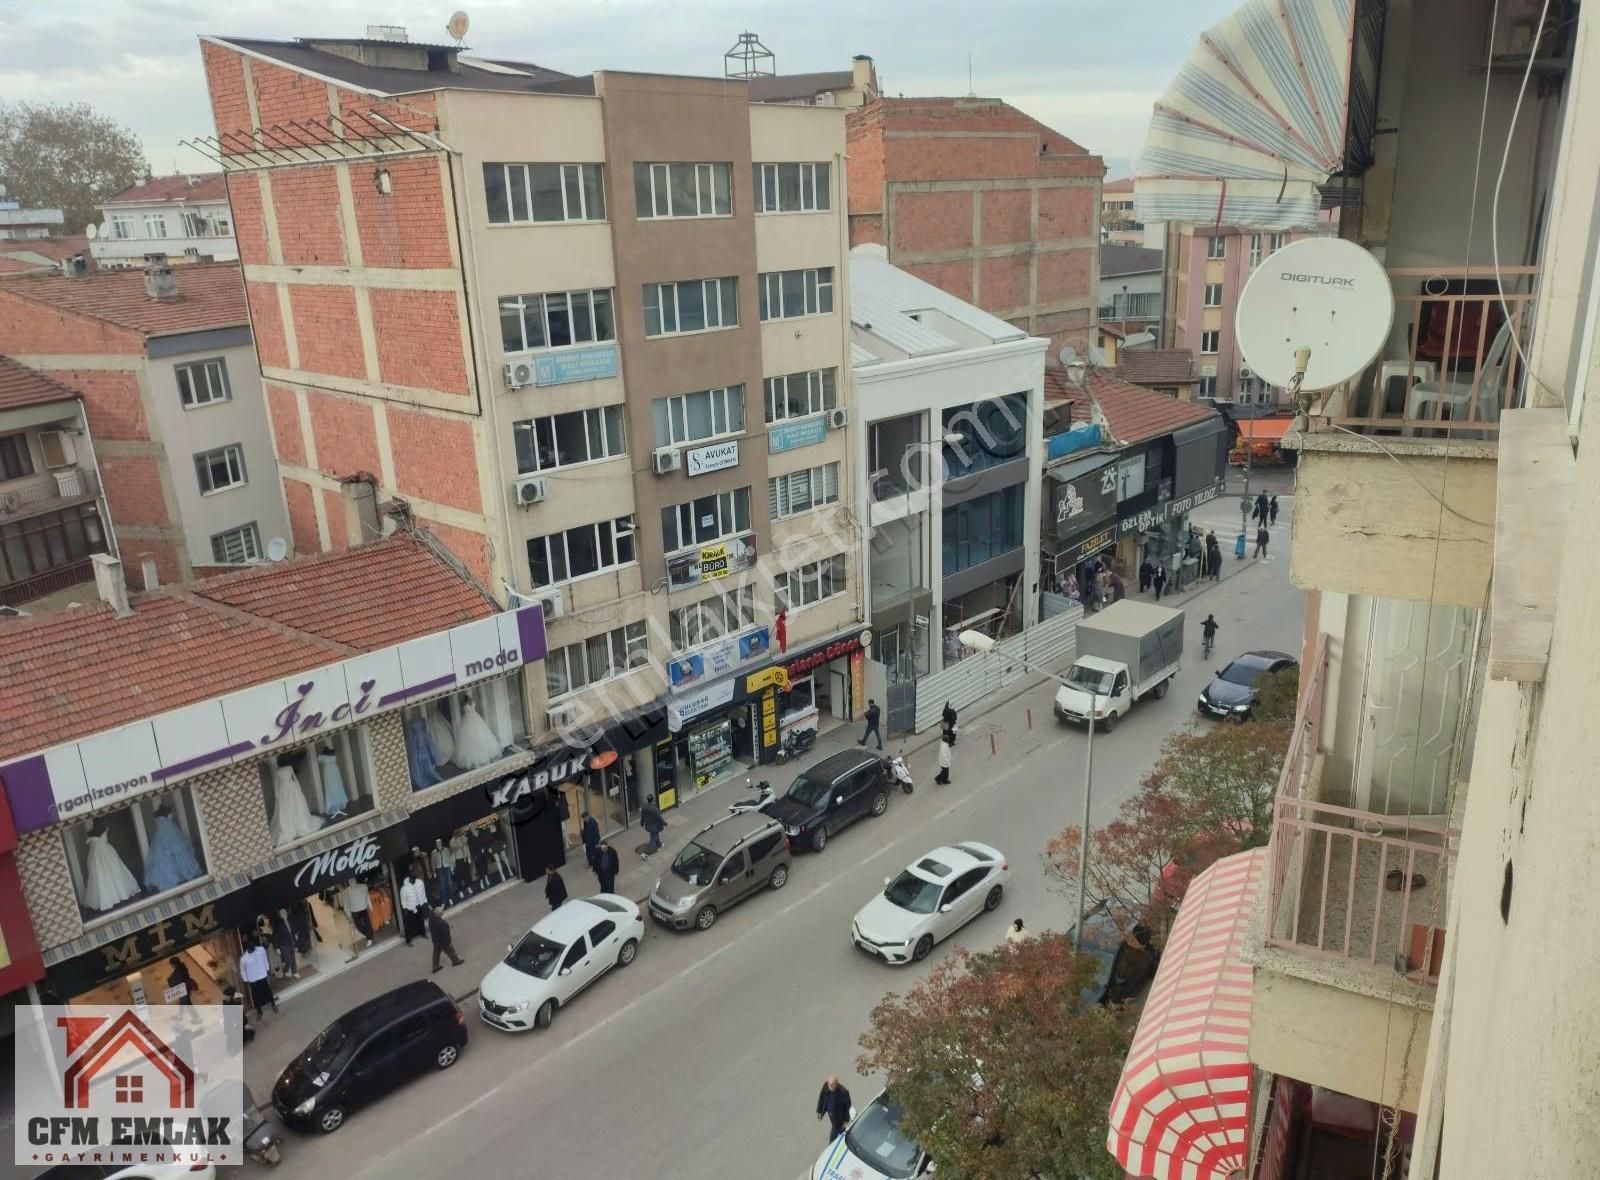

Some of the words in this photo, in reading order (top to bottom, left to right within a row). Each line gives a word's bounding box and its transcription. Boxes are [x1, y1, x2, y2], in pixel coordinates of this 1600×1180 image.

[1281, 272, 1355, 287] DIGITURK
[705, 446, 736, 461] AVUKAT
[1172, 499, 1192, 517] FOTO
[1121, 510, 1152, 532] ÖZLEM
[703, 559, 725, 572] BÜRO
[464, 648, 518, 677] moda
[260, 680, 376, 745] İnci
[492, 753, 589, 808] KABUK
[48, 773, 148, 816] organizasyon
[294, 836, 381, 888] Motto
